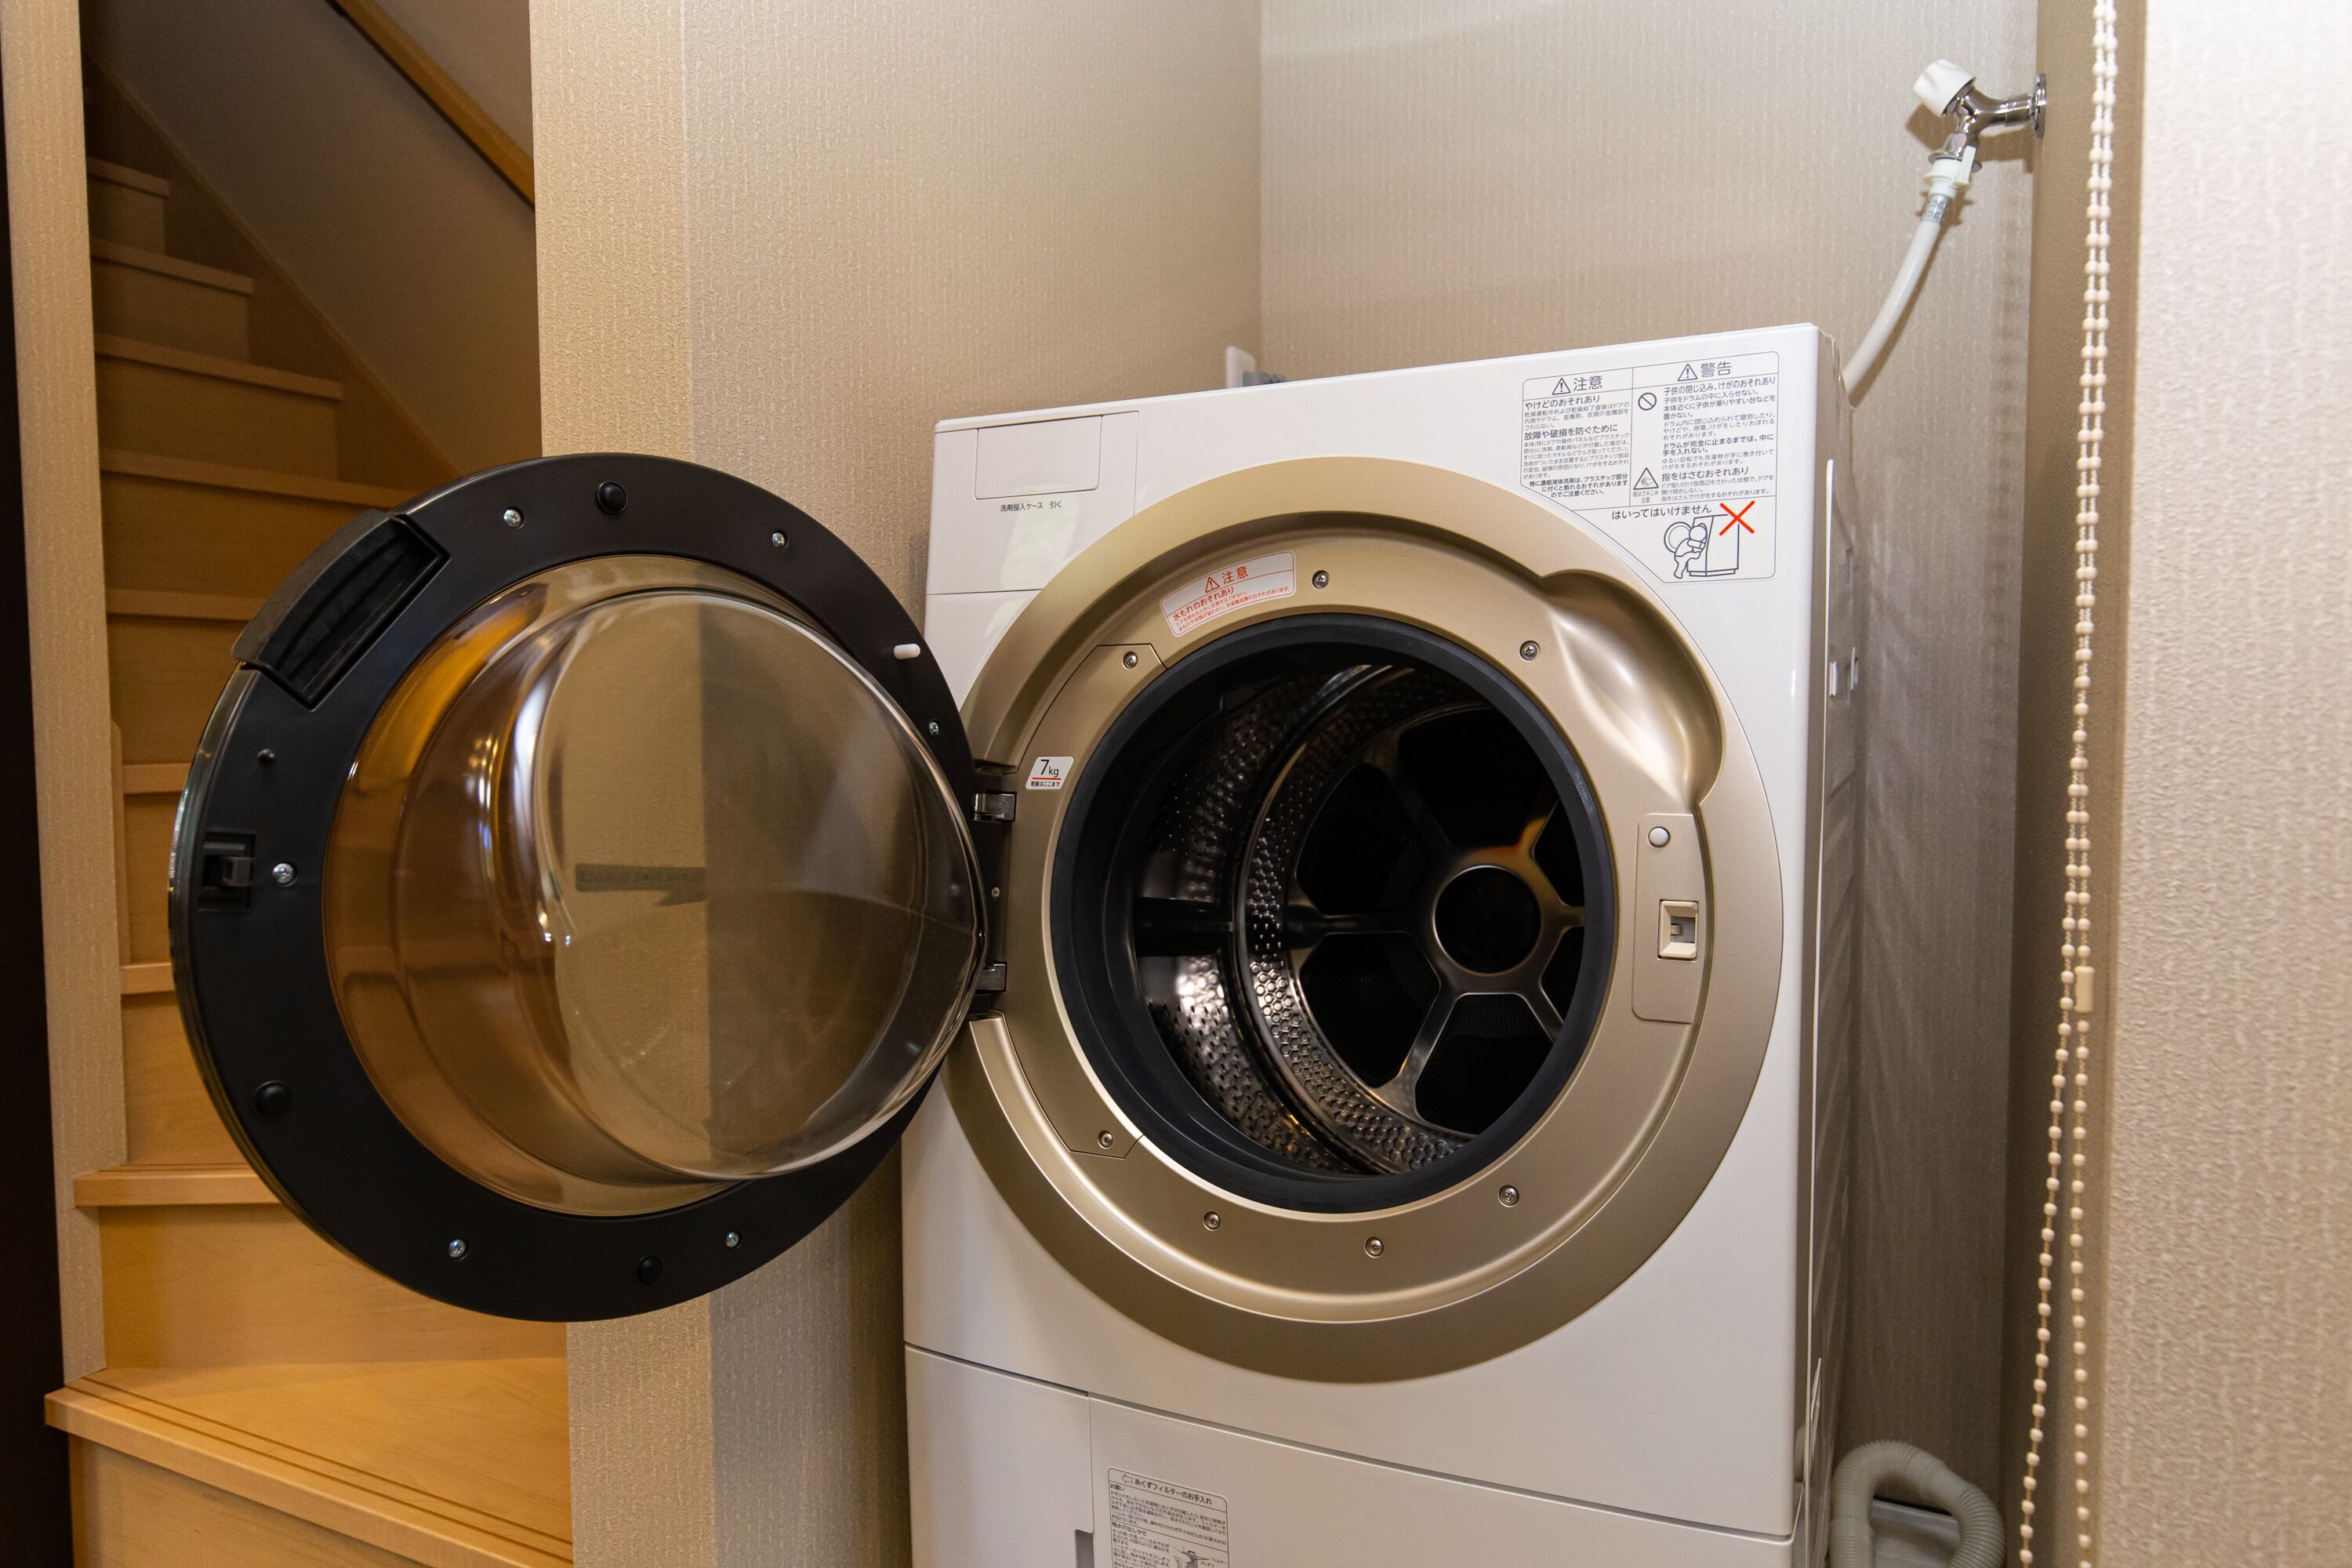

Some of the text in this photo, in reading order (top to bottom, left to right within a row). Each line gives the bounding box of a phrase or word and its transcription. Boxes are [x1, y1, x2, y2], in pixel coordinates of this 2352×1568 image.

[1700, 361, 1732, 378] 警告
[1573, 376, 1602, 392] 注意
[1664, 376, 1776, 395] 子供の閉じ込み、けがのおそれあり
[1525, 394, 1600, 409] やけどのおそれあり
[1664, 388, 1759, 404] 子供をドラムの中に入らせない。
[1664, 394, 1776, 412] 本体近くに子供が乗りやすい台などを
[1663, 411, 1694, 419] 置かない。
[1525, 424, 1617, 441] 故障や破損を防ぐために
[1663, 431, 1718, 441] おそれがあります。
[1663, 433, 1774, 449] ドラムが完全に止まるまでは、中に
[1663, 446, 1708, 456] 手を入れない。
[1662, 459, 1744, 470] けがをするおそれがあります。
[1662, 466, 1749, 481] 指をはさむおそれあり
[1551, 488, 1605, 498] のでご注意ください。
[1000, 502, 1043, 512] 洗剤投入ケース
[1612, 503, 1711, 520] はいってはいけません
[1221, 566, 1249, 584] 注意
[1173, 586, 1234, 621] 水もれのおそれあり
[1040, 759, 1059, 778] 7kg
[1134, 1479, 1213, 1505] 糸くずフィルターのお手入れ
